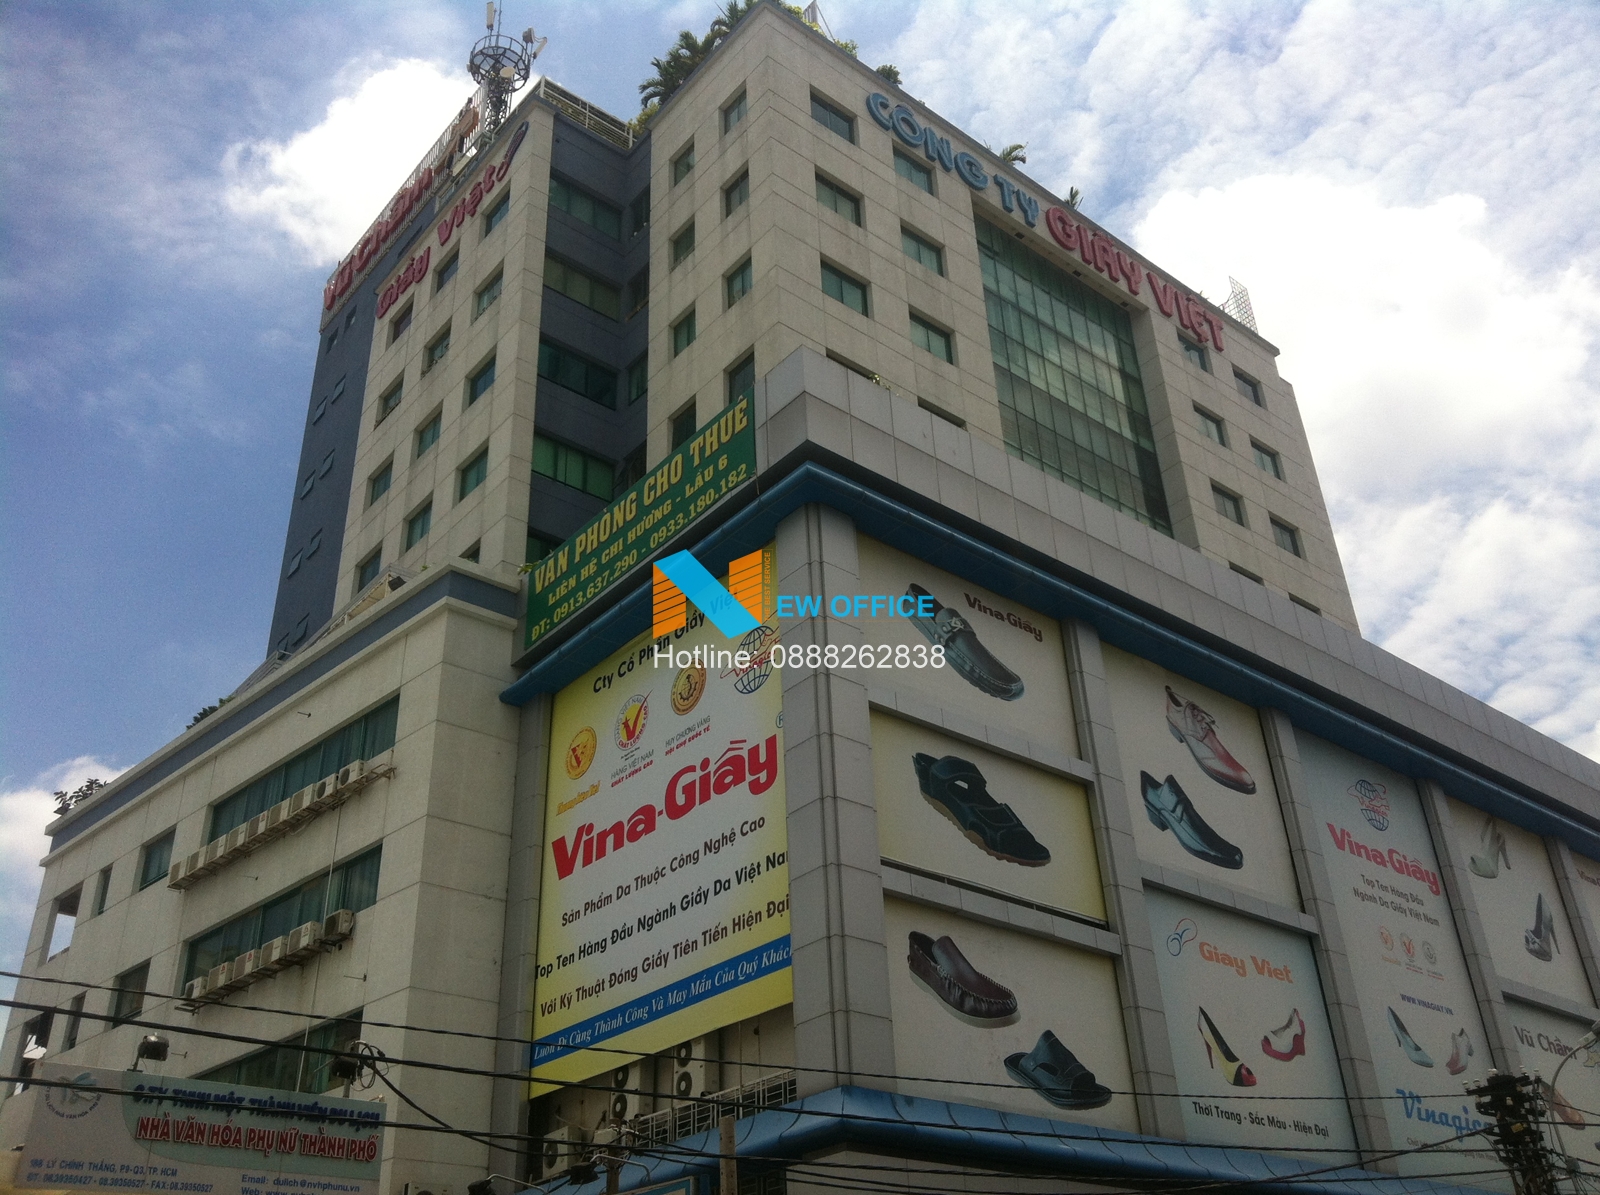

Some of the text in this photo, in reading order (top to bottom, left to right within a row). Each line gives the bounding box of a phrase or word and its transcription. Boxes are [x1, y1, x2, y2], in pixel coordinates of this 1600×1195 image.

[866, 92, 989, 191] CÔNG
[994, 173, 1040, 228] TY
[1146, 271, 1225, 352] VIỆT
[535, 395, 748, 594] VĂN PHÒNG CHO THUÊ
[548, 574, 577, 606] LIÊN
[580, 557, 597, 582] HỆ
[601, 537, 623, 565] CHỊ
[627, 503, 672, 544] HƯƠNG
[685, 464, 714, 498] LẦU
[718, 454, 728, 470] 6
[531, 618, 550, 641] ĐT:
[553, 549, 638, 623] 0913.637.290
[650, 463, 747, 548] 0933.180.182
[593, 673, 613, 693] Cty
[618, 651, 635, 677] Cổ
[561, 816, 765, 927] Sản Phẩm Da Thuộc Công Nghệ Cao
[1361, 874, 1375, 888] Top
[535, 963, 553, 981] Top
[556, 951, 575, 970] Ten
[578, 935, 607, 960] Hàng
[611, 921, 633, 945] Đầu
[637, 902, 676, 930] Ngành
[680, 886, 710, 912] Giầy
[714, 875, 731, 893] Da
[735, 862, 761, 886] Việt
[560, 989, 573, 1011] Kỹ
[576, 976, 606, 1004] Thuật
[608, 963, 638, 989] Đóng
[642, 949, 669, 974] Giầy
[673, 936, 698, 960] Tiên
[702, 921, 728, 946] Tiến
[732, 909, 762, 935] Hiện
[767, 897, 790, 919] Đại
[569, 1023, 592, 1046] Cùng
[594, 1014, 623, 1036] Thành
[625, 1006, 648, 1027] Công
[651, 994, 664, 1012] Và
[667, 987, 687, 1007] May
[689, 974, 712, 998] Mắn
[714, 966, 735, 987] Của
[737, 956, 758, 981] Quý
[761, 942, 792, 967] Khác
[1199, 941, 1293, 984] Giay Viet
[1513, 1025, 1535, 1049] Vũ
[137, 1111, 380, 1163] NHÀ VĂN HÓA PHỤ NỮ THÀNH PHỐ
[1192, 1101, 1213, 1117] Thời
[1214, 1106, 1242, 1125] Trang
[1249, 1111, 1265, 1126] Sắc
[1267, 1115, 1287, 1130] Màu
[1293, 1119, 1313, 1136] Hiện
[1314, 1123, 1329, 1140] Đại
[46, 1157, 57, 1169] LÝ
[60, 1158, 84, 1170] CHÍNH
[160, 1167, 178, 1177] HCM
[241, 1174, 268, 1185] Email:
